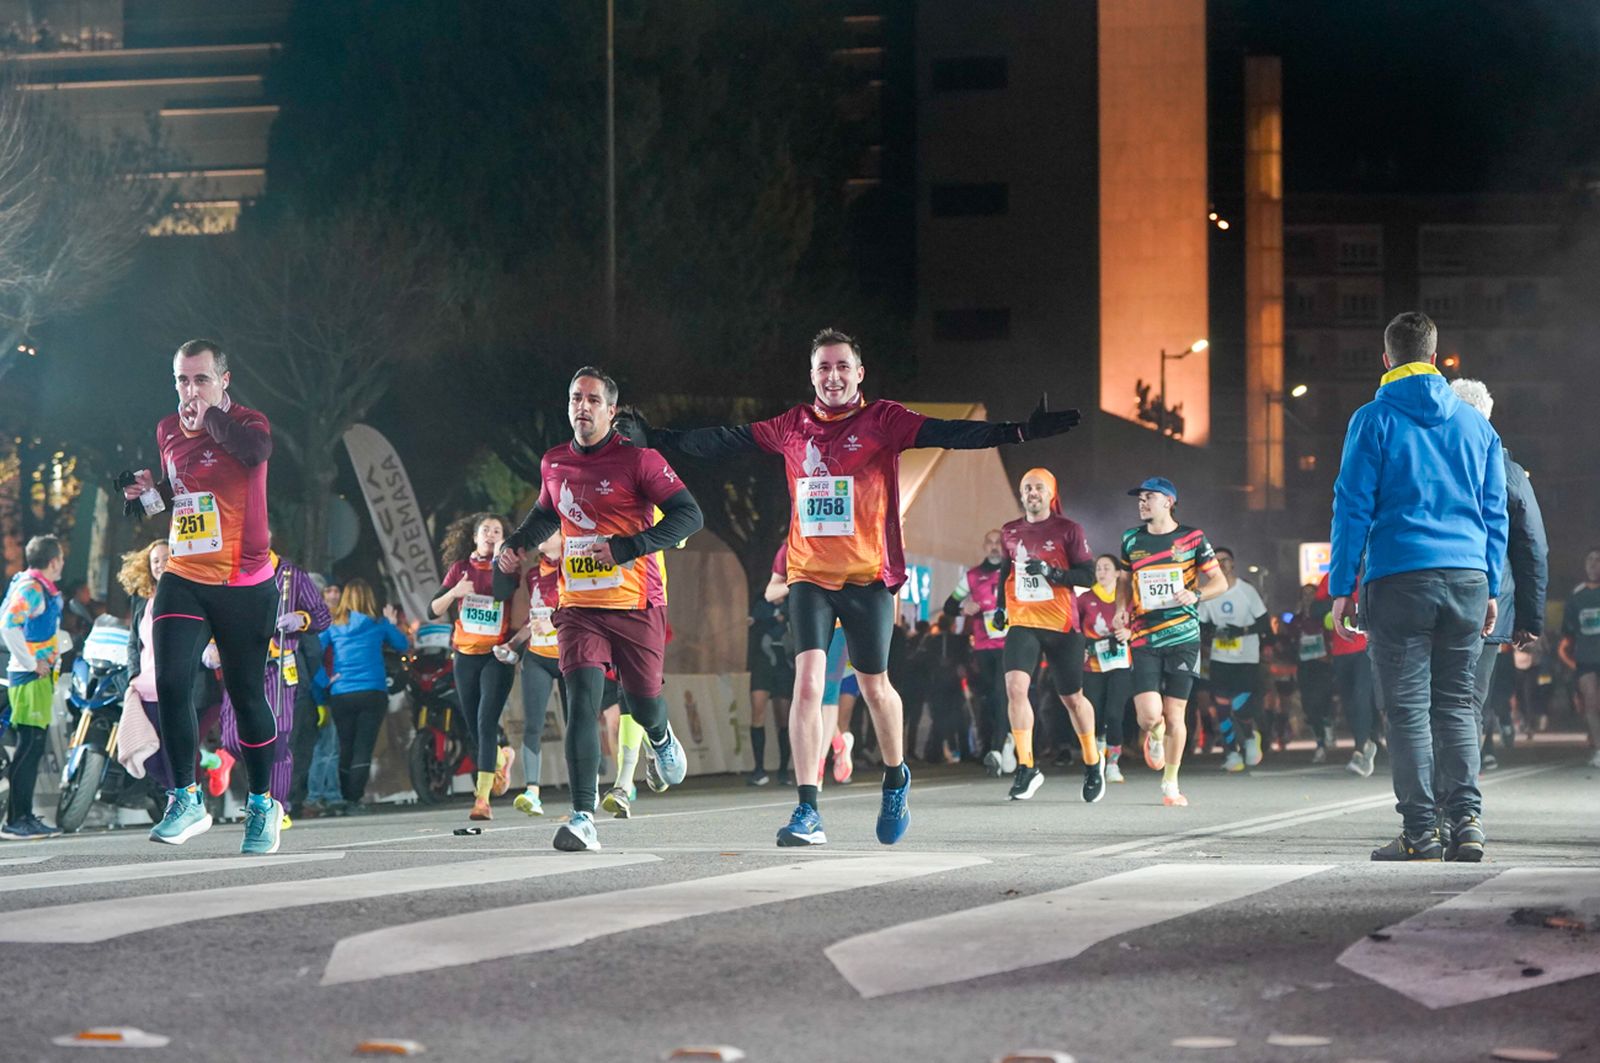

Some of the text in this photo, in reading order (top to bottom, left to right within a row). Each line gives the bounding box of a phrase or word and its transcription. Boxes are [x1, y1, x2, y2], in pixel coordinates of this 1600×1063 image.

[806, 497, 845, 517] 3758
[177, 514, 205, 534] 251
[381, 453, 437, 586] JAPEMASA
[1149, 583, 1175, 597] 5271
[466, 607, 498, 624] 13594
